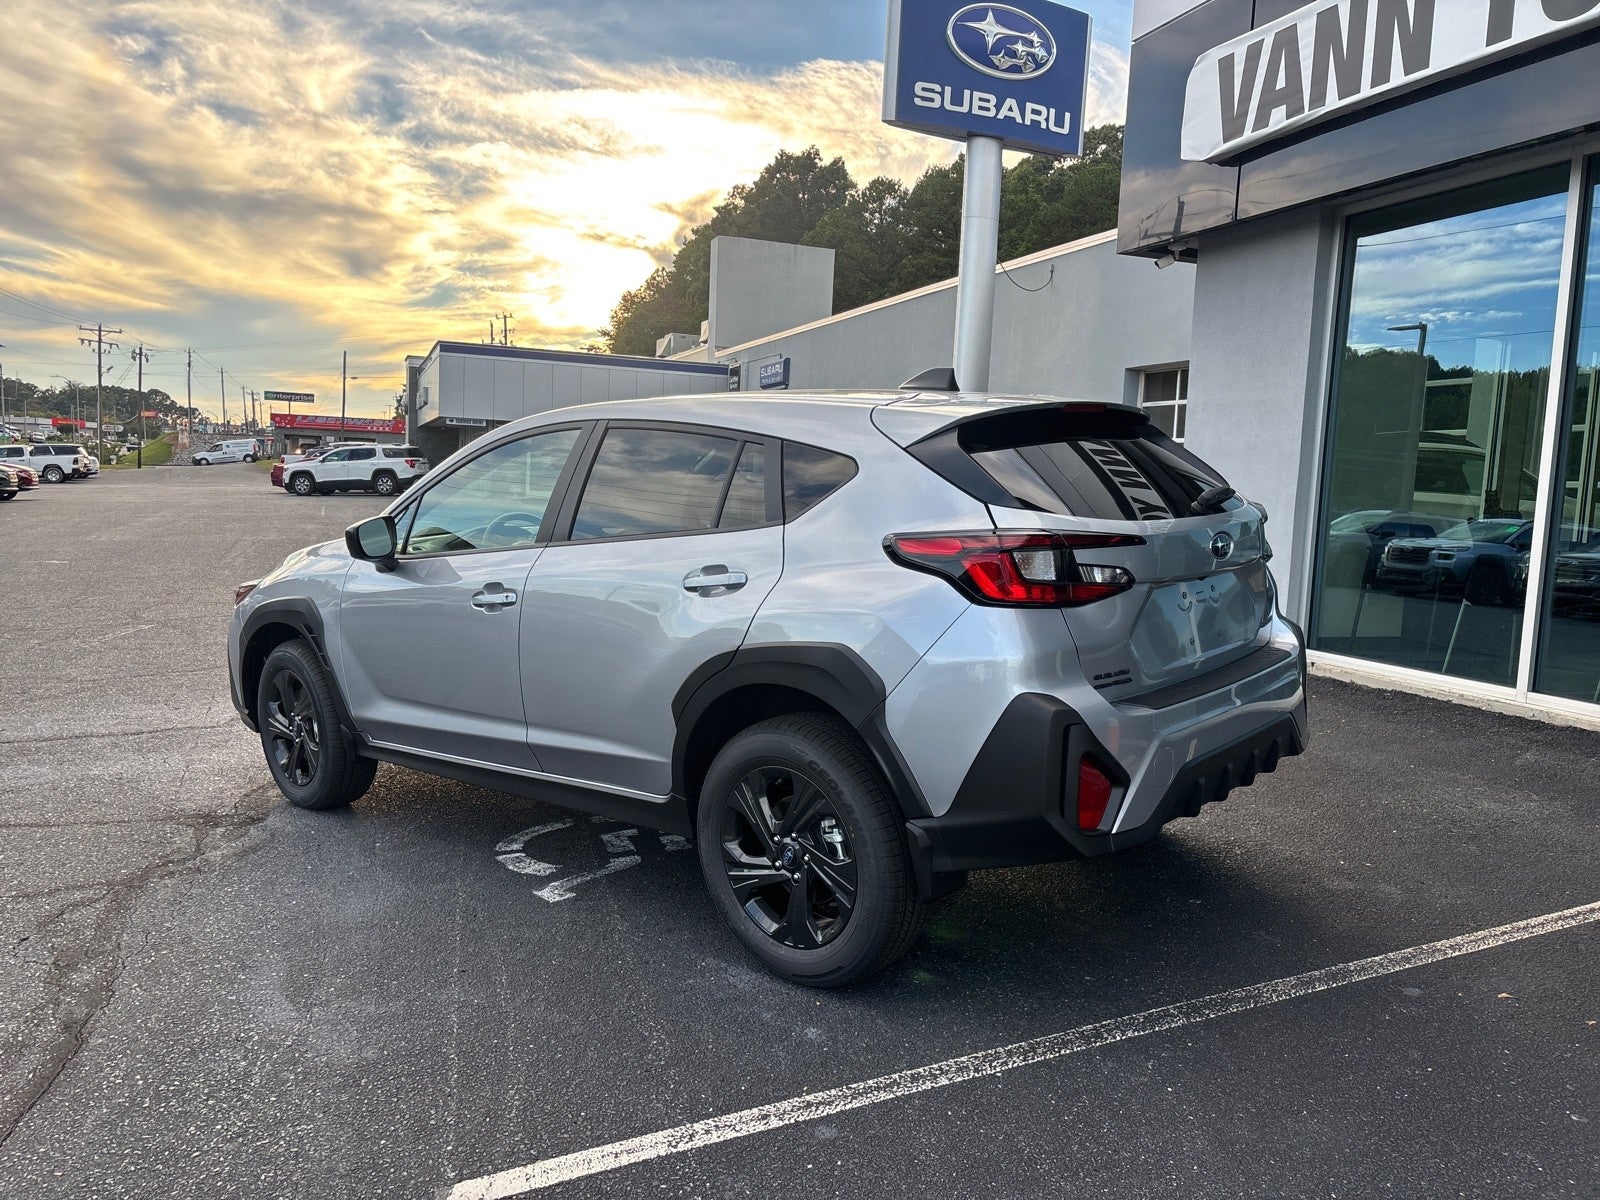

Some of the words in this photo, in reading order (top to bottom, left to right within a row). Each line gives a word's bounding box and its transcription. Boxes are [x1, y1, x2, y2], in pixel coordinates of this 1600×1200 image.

[1217, 0, 1436, 144] VANN
[913, 81, 1071, 135] SUBARU
[761, 364, 783, 376] SUBARU
[266, 392, 314, 402] enterprise
